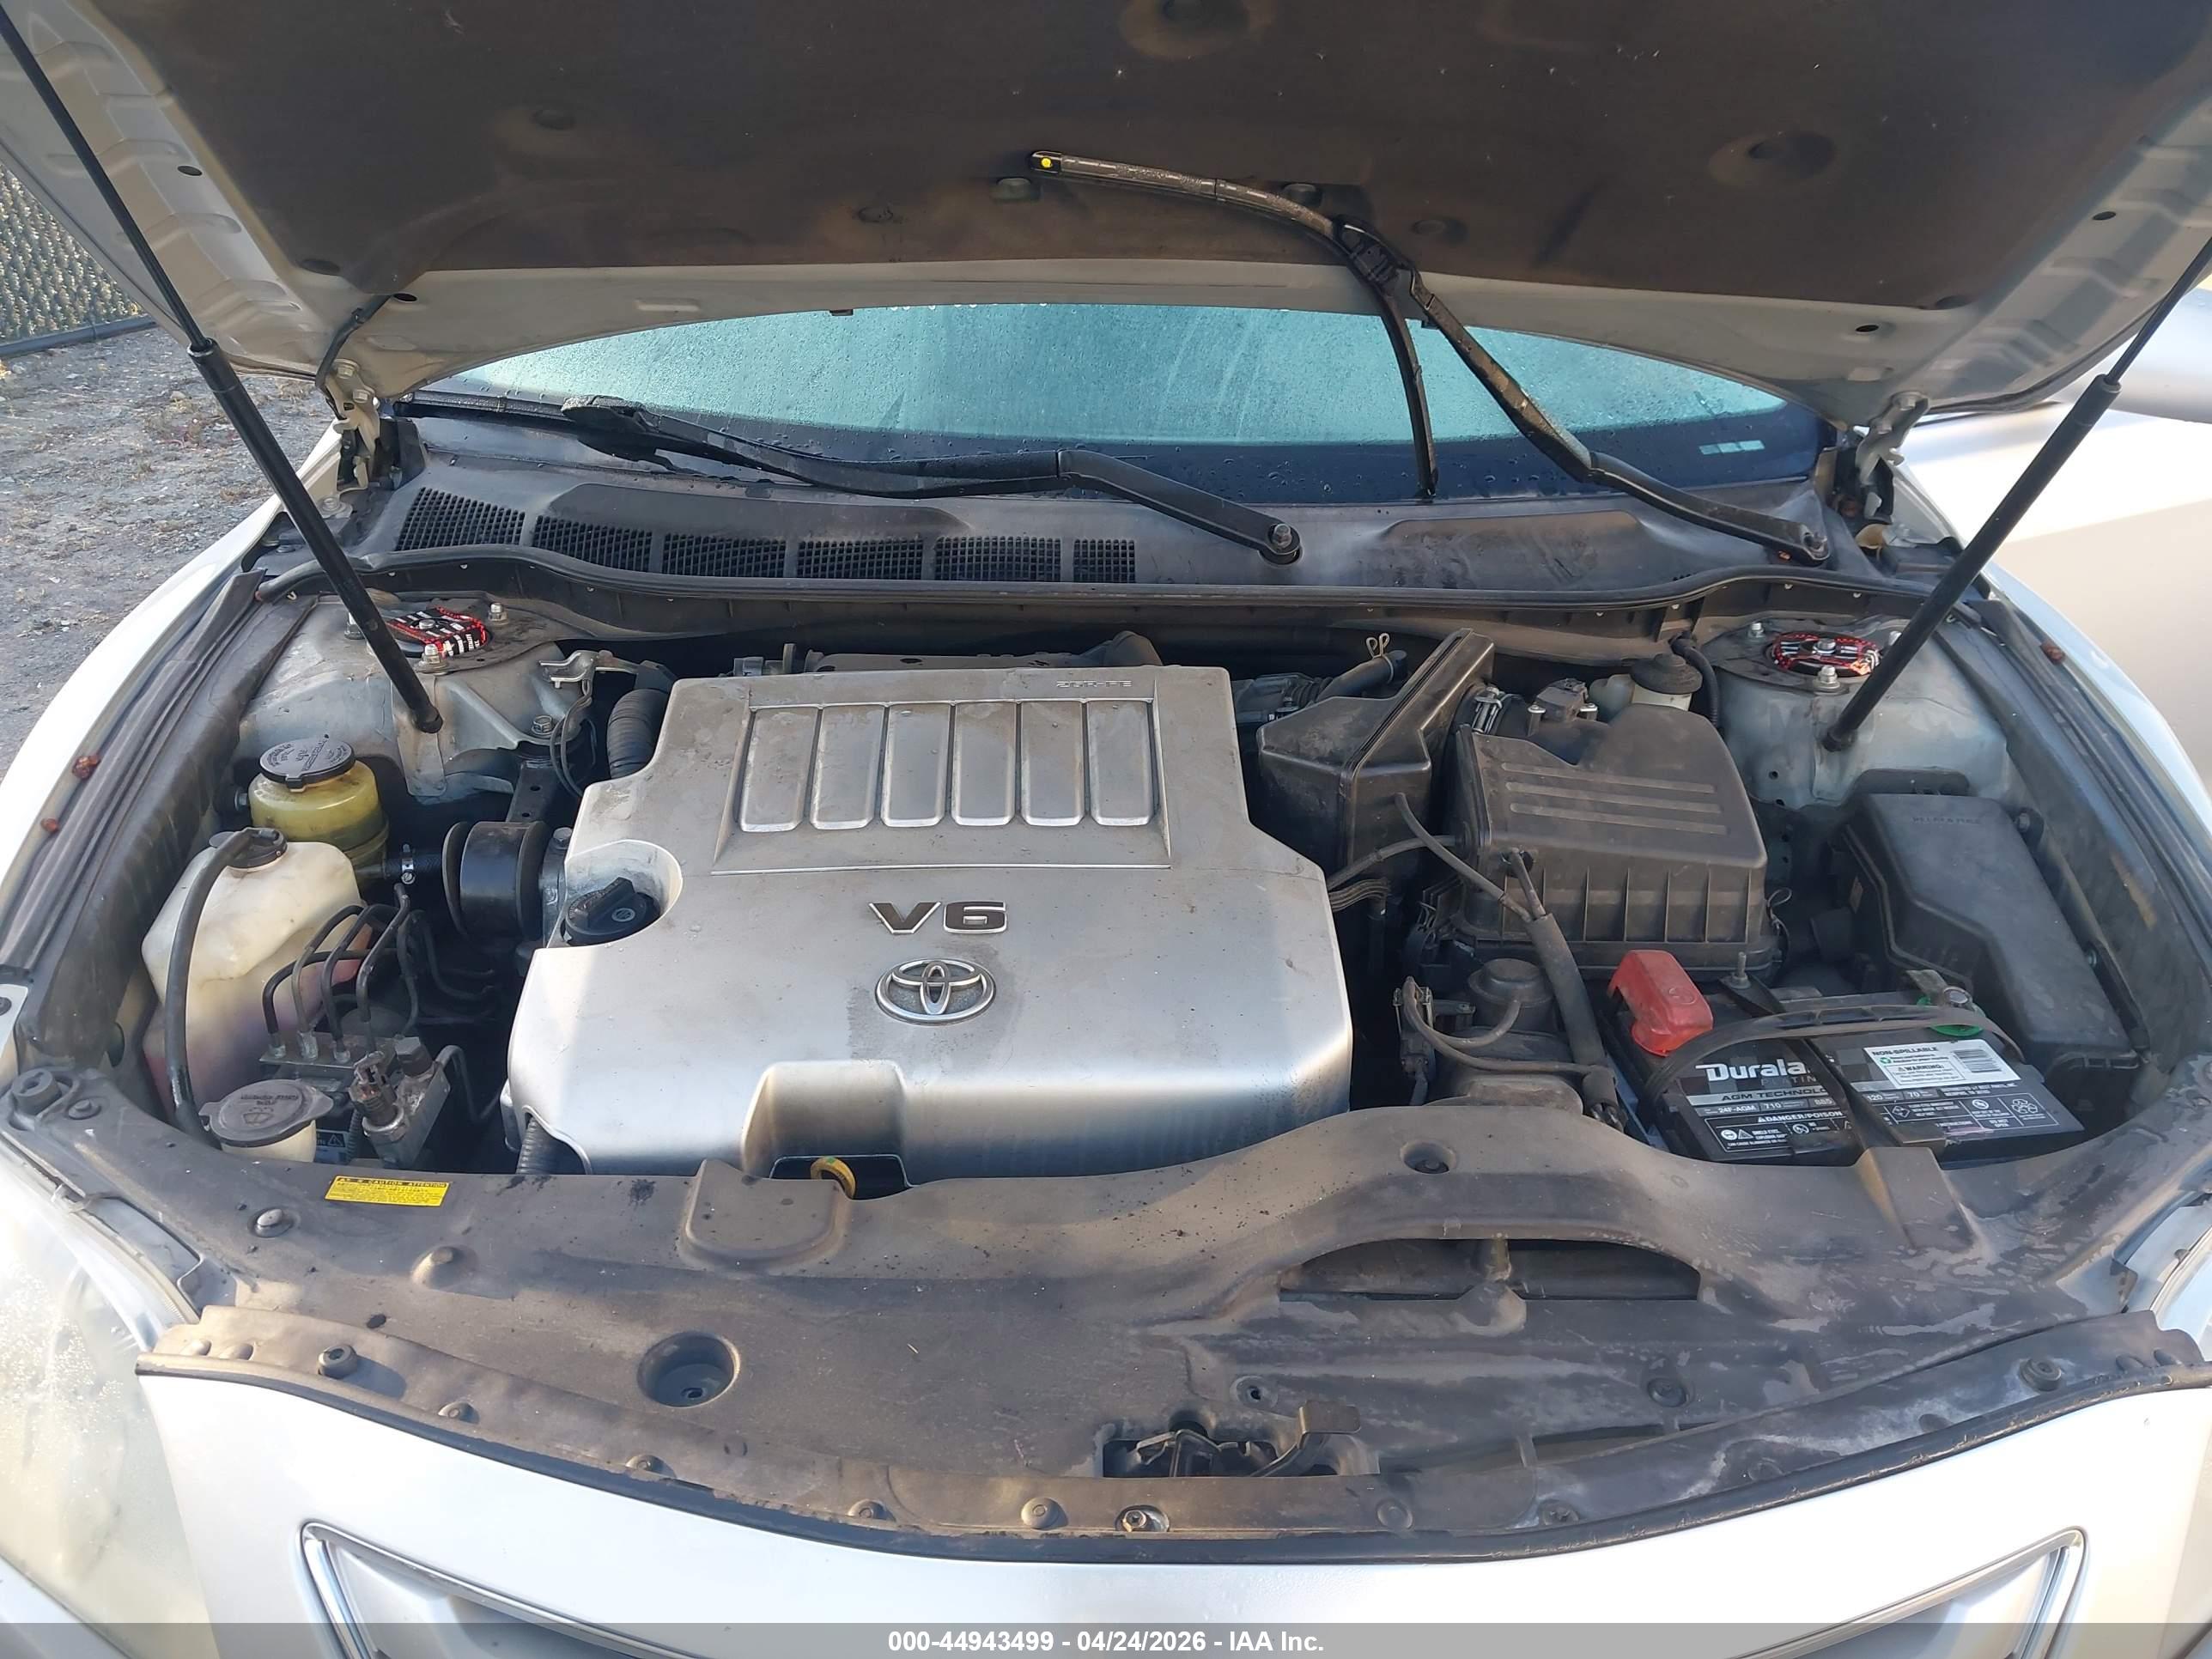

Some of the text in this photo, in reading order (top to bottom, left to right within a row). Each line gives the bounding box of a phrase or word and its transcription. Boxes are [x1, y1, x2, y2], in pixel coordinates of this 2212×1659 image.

[868, 901, 1007, 934] V6
[1872, 1047, 1939, 1056] NON-SPILLABLE
[1695, 1058, 1809, 1082] Durala
[1722, 1091, 1753, 1102] AGM
[1765, 1110, 1844, 1122] DANGER/POISON
